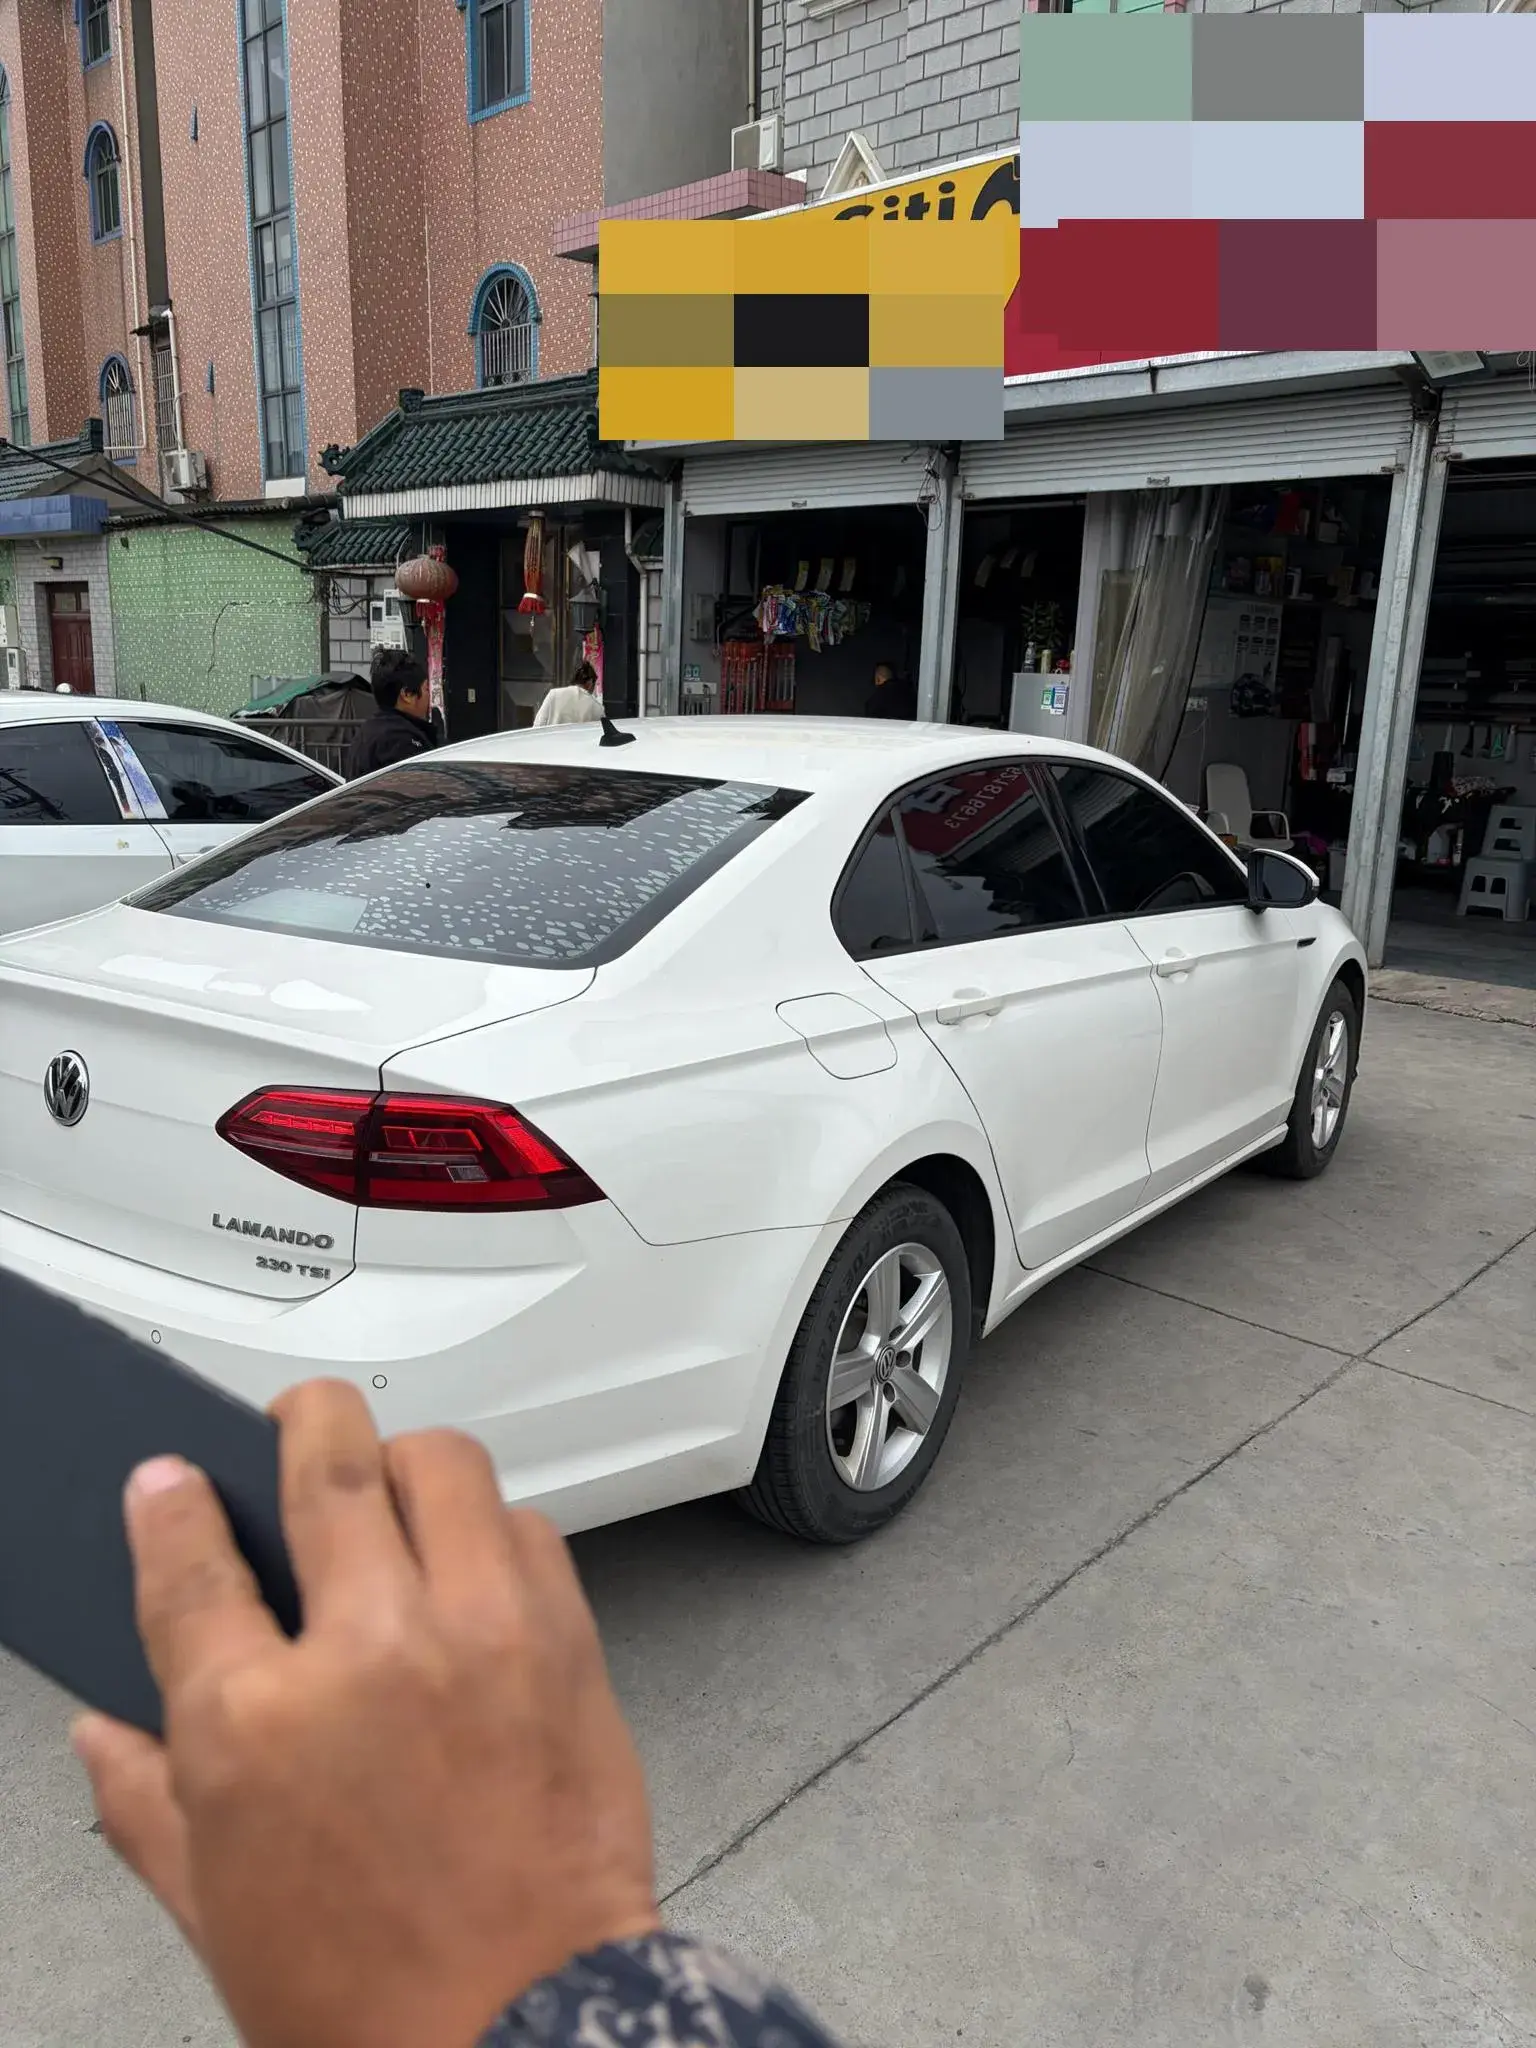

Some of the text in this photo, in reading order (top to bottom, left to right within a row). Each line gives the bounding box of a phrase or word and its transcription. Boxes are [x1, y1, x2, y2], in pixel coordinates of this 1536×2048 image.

[212, 1213, 334, 1249] LAMANDO
[256, 1255, 331, 1280] 230 TSI
